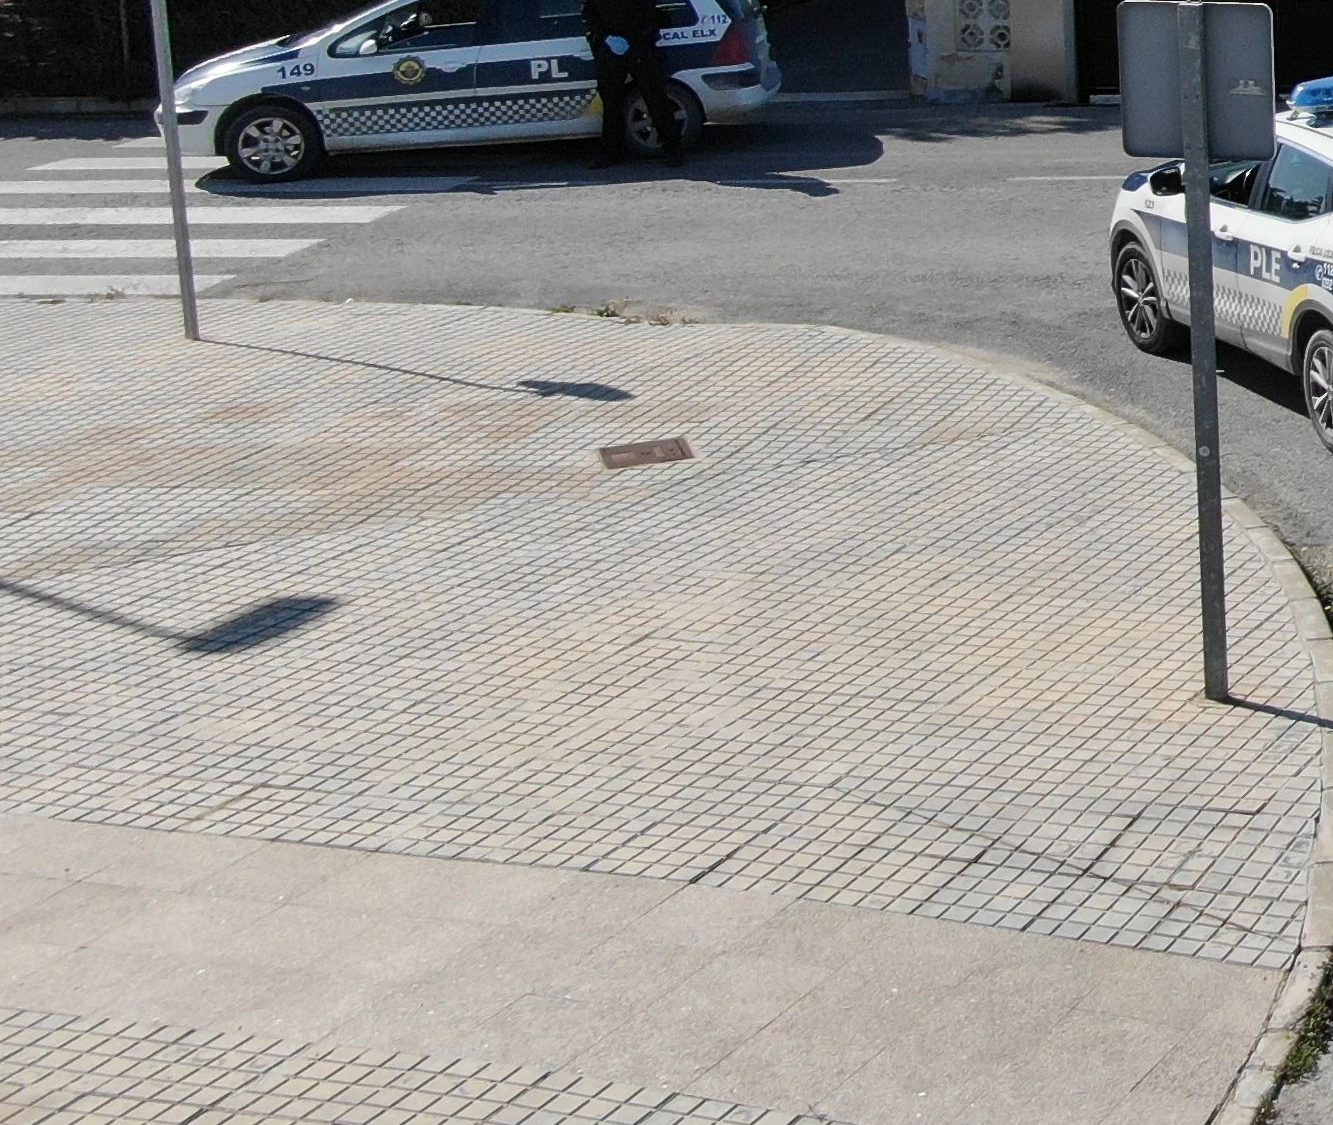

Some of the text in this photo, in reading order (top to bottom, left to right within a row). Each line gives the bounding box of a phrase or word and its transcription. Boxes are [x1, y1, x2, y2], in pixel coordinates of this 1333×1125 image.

[710, 14, 728, 25] 112
[692, 28, 717, 38] ELX
[276, 62, 315, 80] 149
[530, 59, 569, 80] PL
[1250, 244, 1281, 284] PLE
